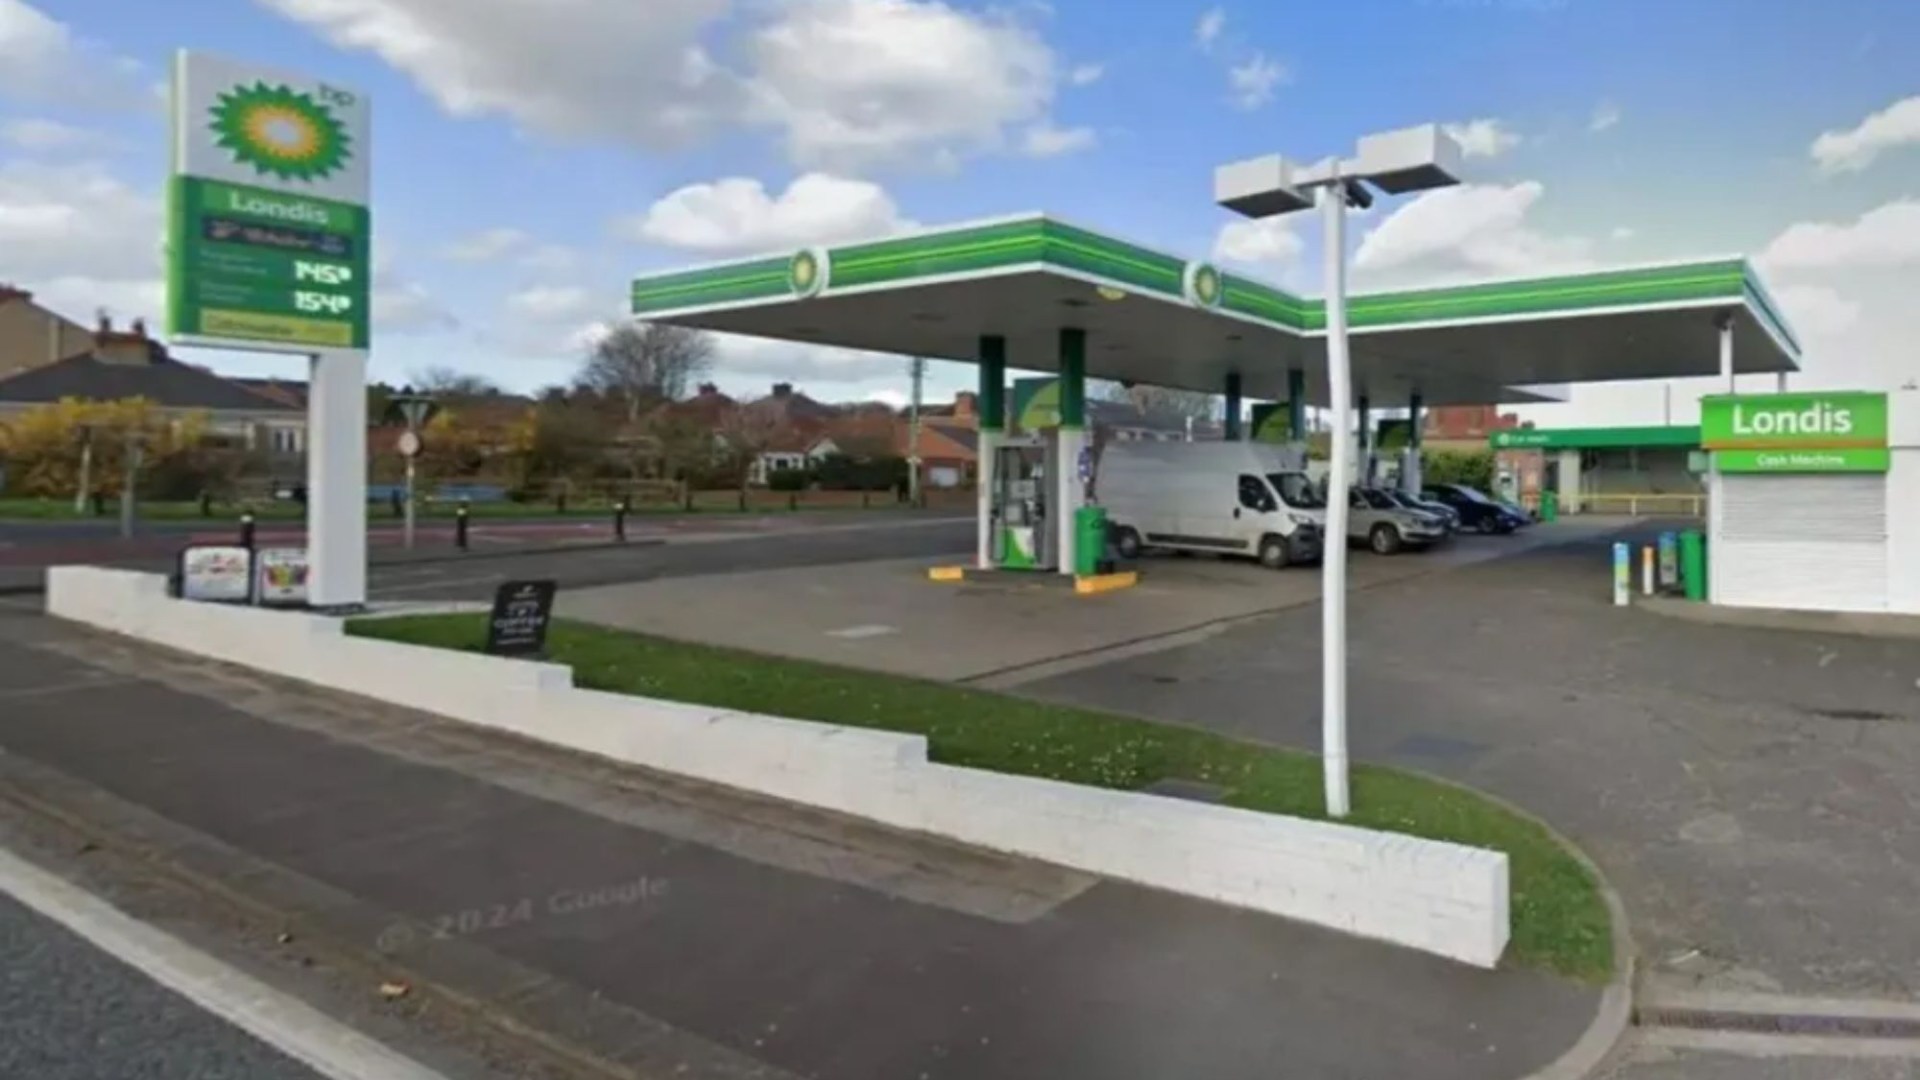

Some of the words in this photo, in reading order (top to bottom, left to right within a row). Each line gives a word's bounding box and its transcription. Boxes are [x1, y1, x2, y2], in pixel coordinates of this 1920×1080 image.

[319, 82, 356, 107] bp
[229, 190, 330, 225] Londis
[1733, 402, 1852, 434] Londis
[1756, 454, 1787, 466] Cash
[1791, 452, 1845, 466] Machine
